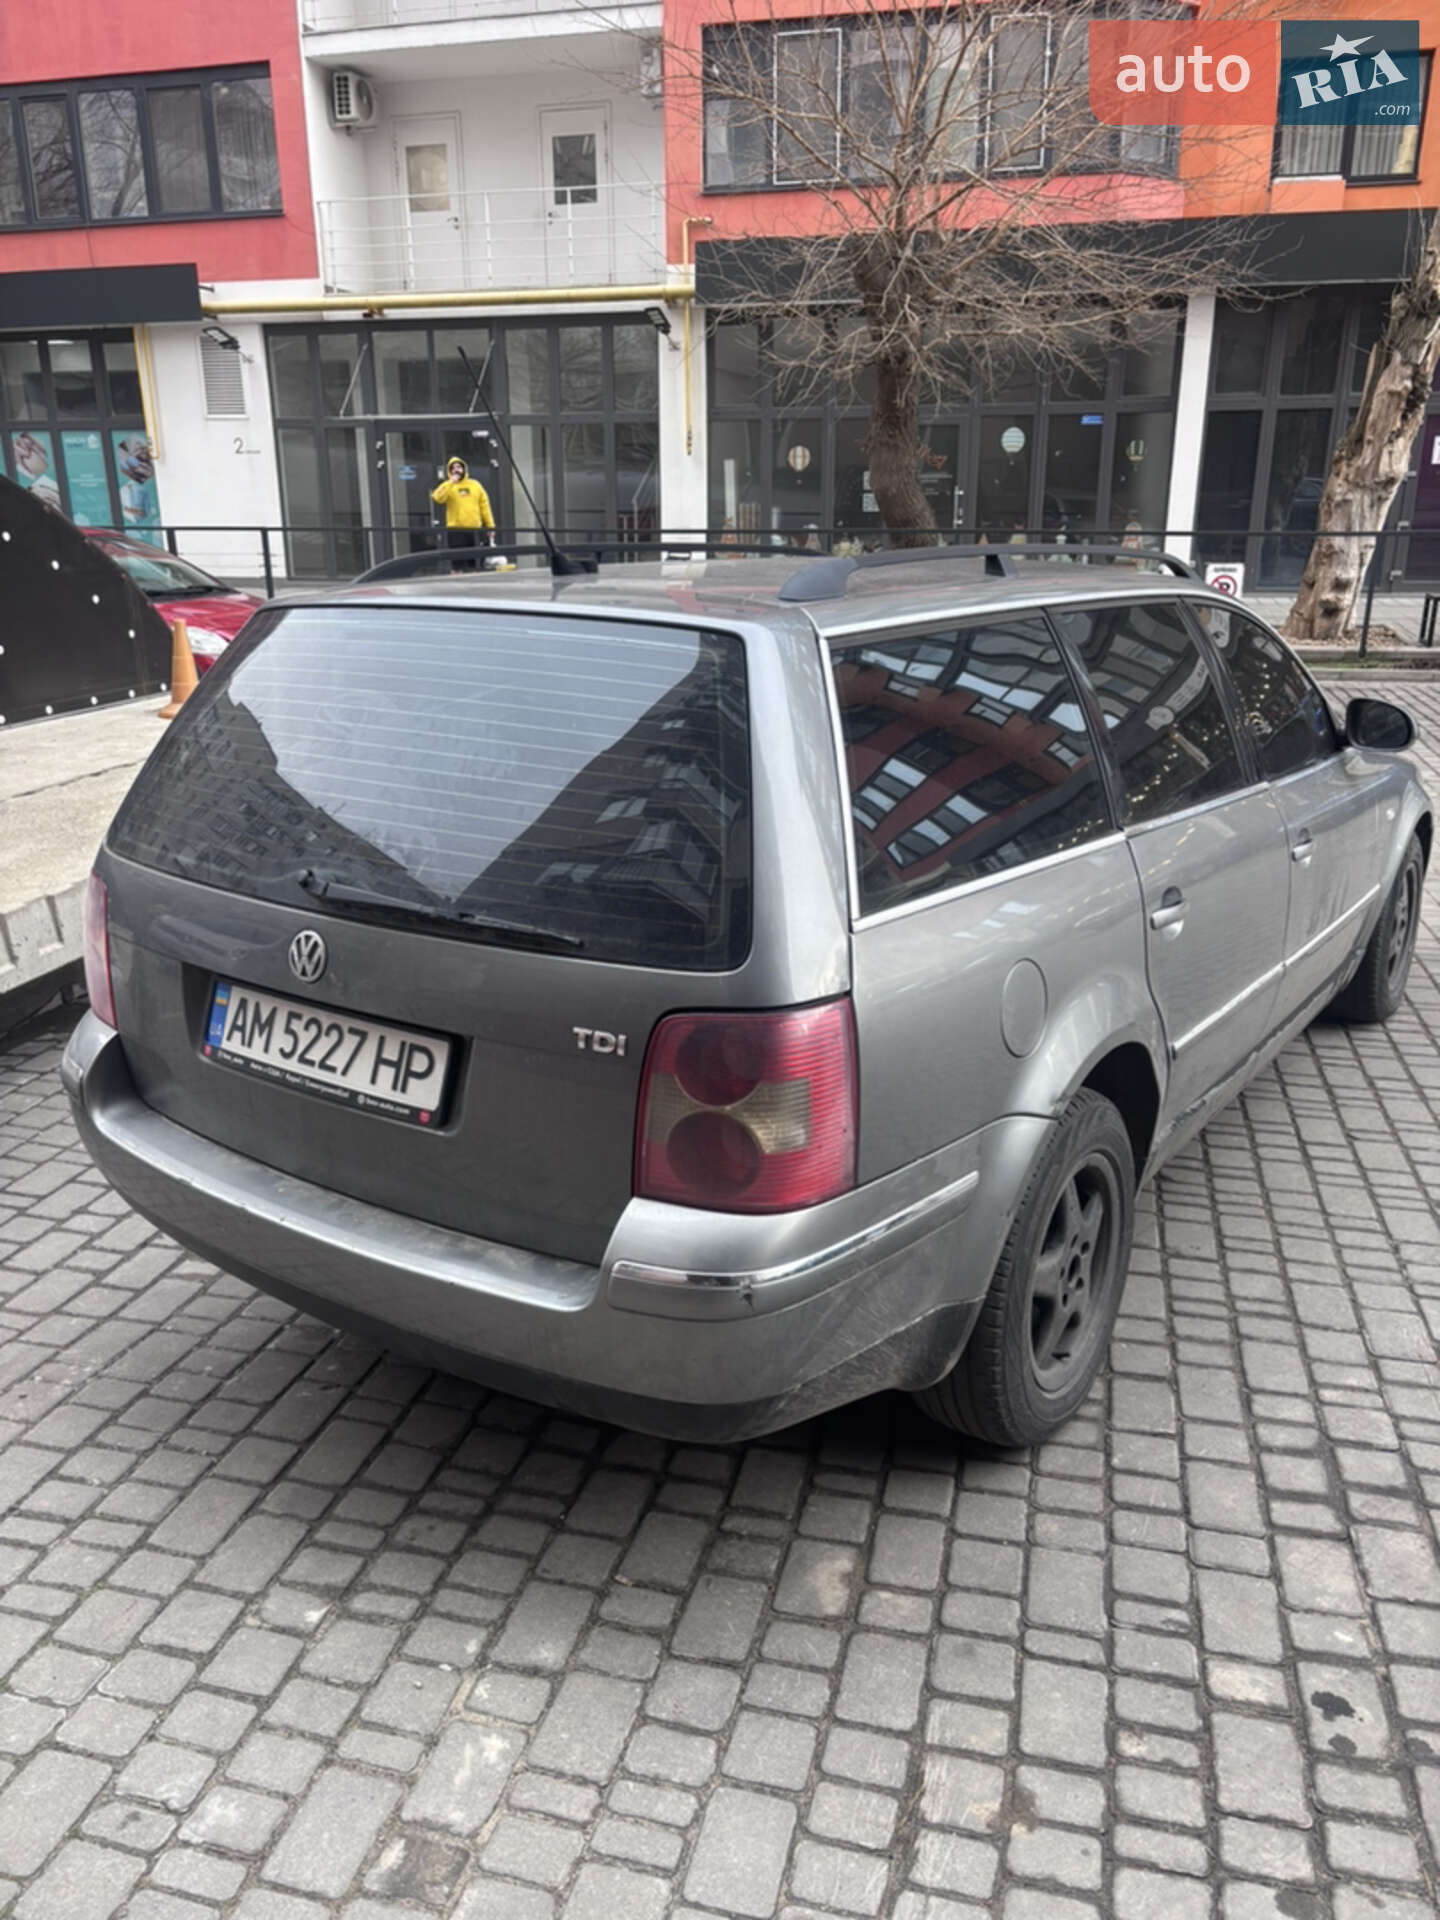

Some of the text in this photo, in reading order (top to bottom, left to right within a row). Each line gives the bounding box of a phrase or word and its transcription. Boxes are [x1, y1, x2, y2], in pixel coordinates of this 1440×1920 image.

[233, 436, 244, 455] 2
[226, 997, 277, 1054] AM
[279, 1010, 368, 1077] 5227
[370, 1034, 435, 1094] HP
[572, 1026, 627, 1056] TDI
